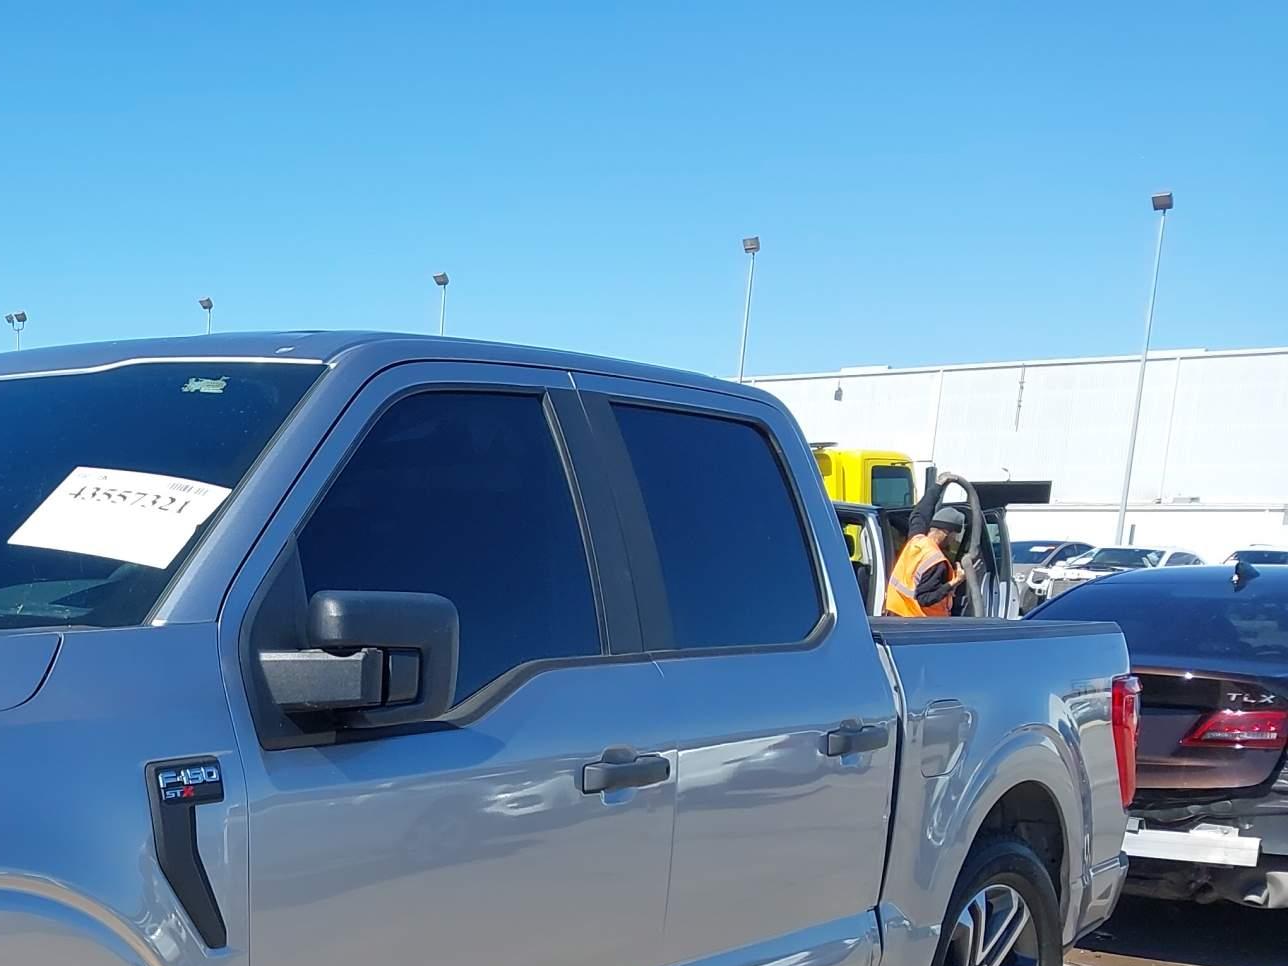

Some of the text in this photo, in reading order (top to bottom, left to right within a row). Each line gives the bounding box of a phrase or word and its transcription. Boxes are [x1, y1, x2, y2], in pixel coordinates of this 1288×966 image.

[68, 486, 191, 515] 43557321
[1226, 692, 1277, 704] TLX
[158, 766, 220, 788] F-150
[164, 786, 195, 799] STX
